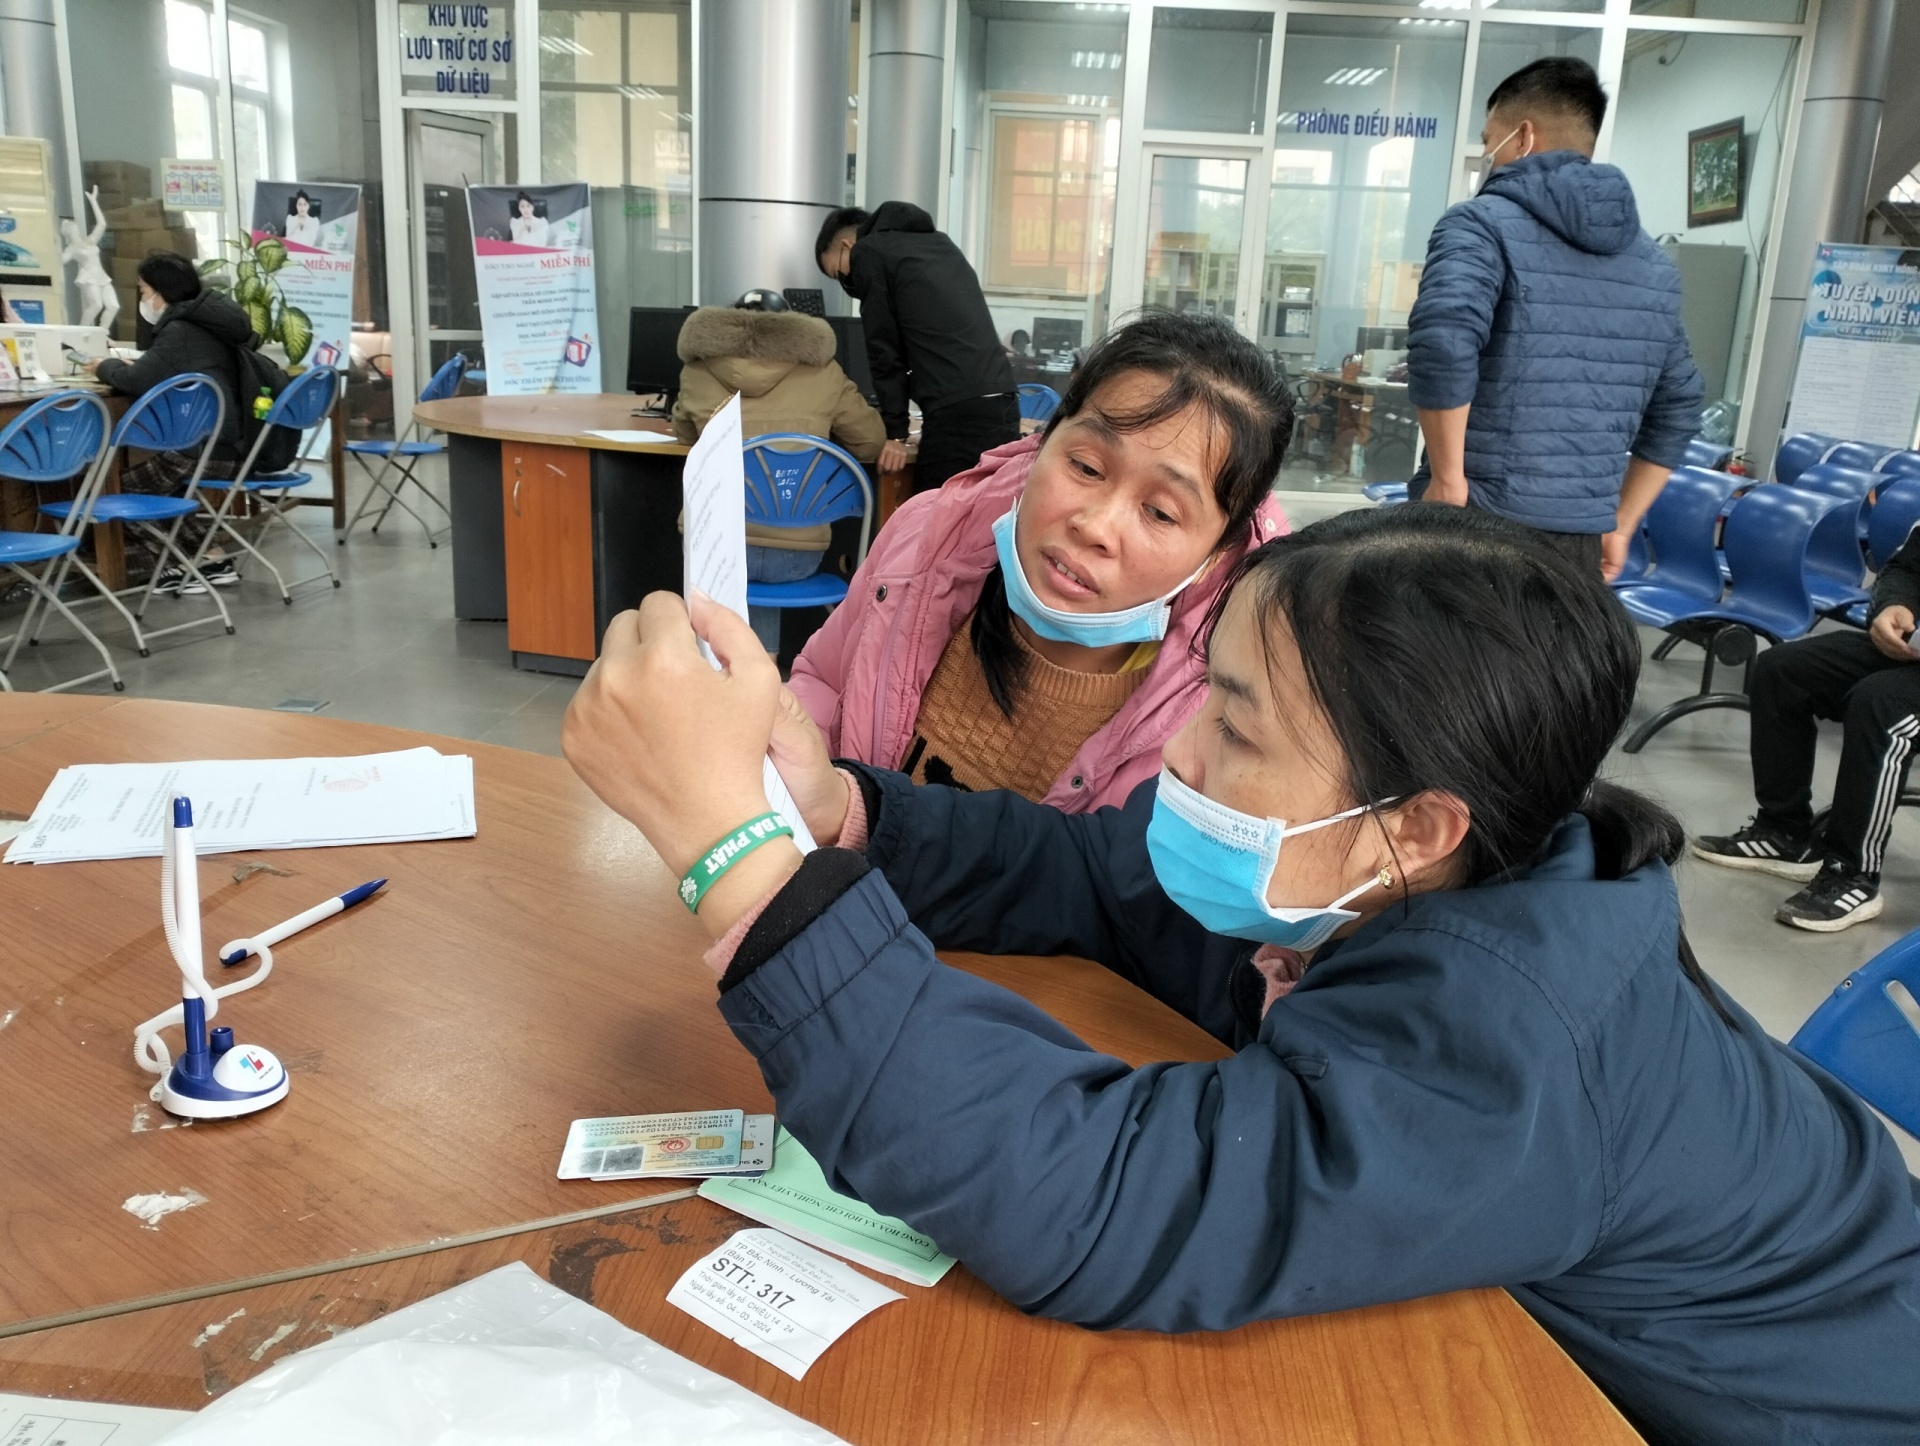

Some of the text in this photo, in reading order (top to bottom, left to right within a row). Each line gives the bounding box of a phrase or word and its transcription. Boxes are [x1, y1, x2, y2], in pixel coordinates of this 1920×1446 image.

[428, 4, 488, 34] KHU VỰC
[407, 31, 512, 63] LƯU TRỮ CƠ SỞ
[436, 65, 490, 99] DỮ LIỆU
[1296, 107, 1350, 135] PHÒNG
[1394, 112, 1438, 139] HÀNH
[305, 256, 353, 272] MIỄN PHÍ
[540, 254, 571, 270] MIỄN
[573, 254, 591, 268] PHÍ
[1882, 287, 1920, 308] DỤN
[781, 489, 792, 499] 19
[704, 831, 752, 875] PHẬT
[735, 1242, 748, 1251] TP
[747, 1249, 764, 1262] Bắc
[763, 1259, 785, 1273] Ninh
[789, 1273, 820, 1295] Lương
[821, 1291, 835, 1303] Tài
[745, 1259, 757, 1269] 1)
[712, 1257, 796, 1309] STT: 317
[688, 1279, 706, 1294] Ngày
[726, 1302, 737, 1312] 04
[739, 1311, 751, 1321] 03
[753, 1320, 772, 1334] 2024
[698, 1270, 713, 1284] Thời
[712, 1280, 728, 1292] gian
[783, 1324, 796, 1334] 24
